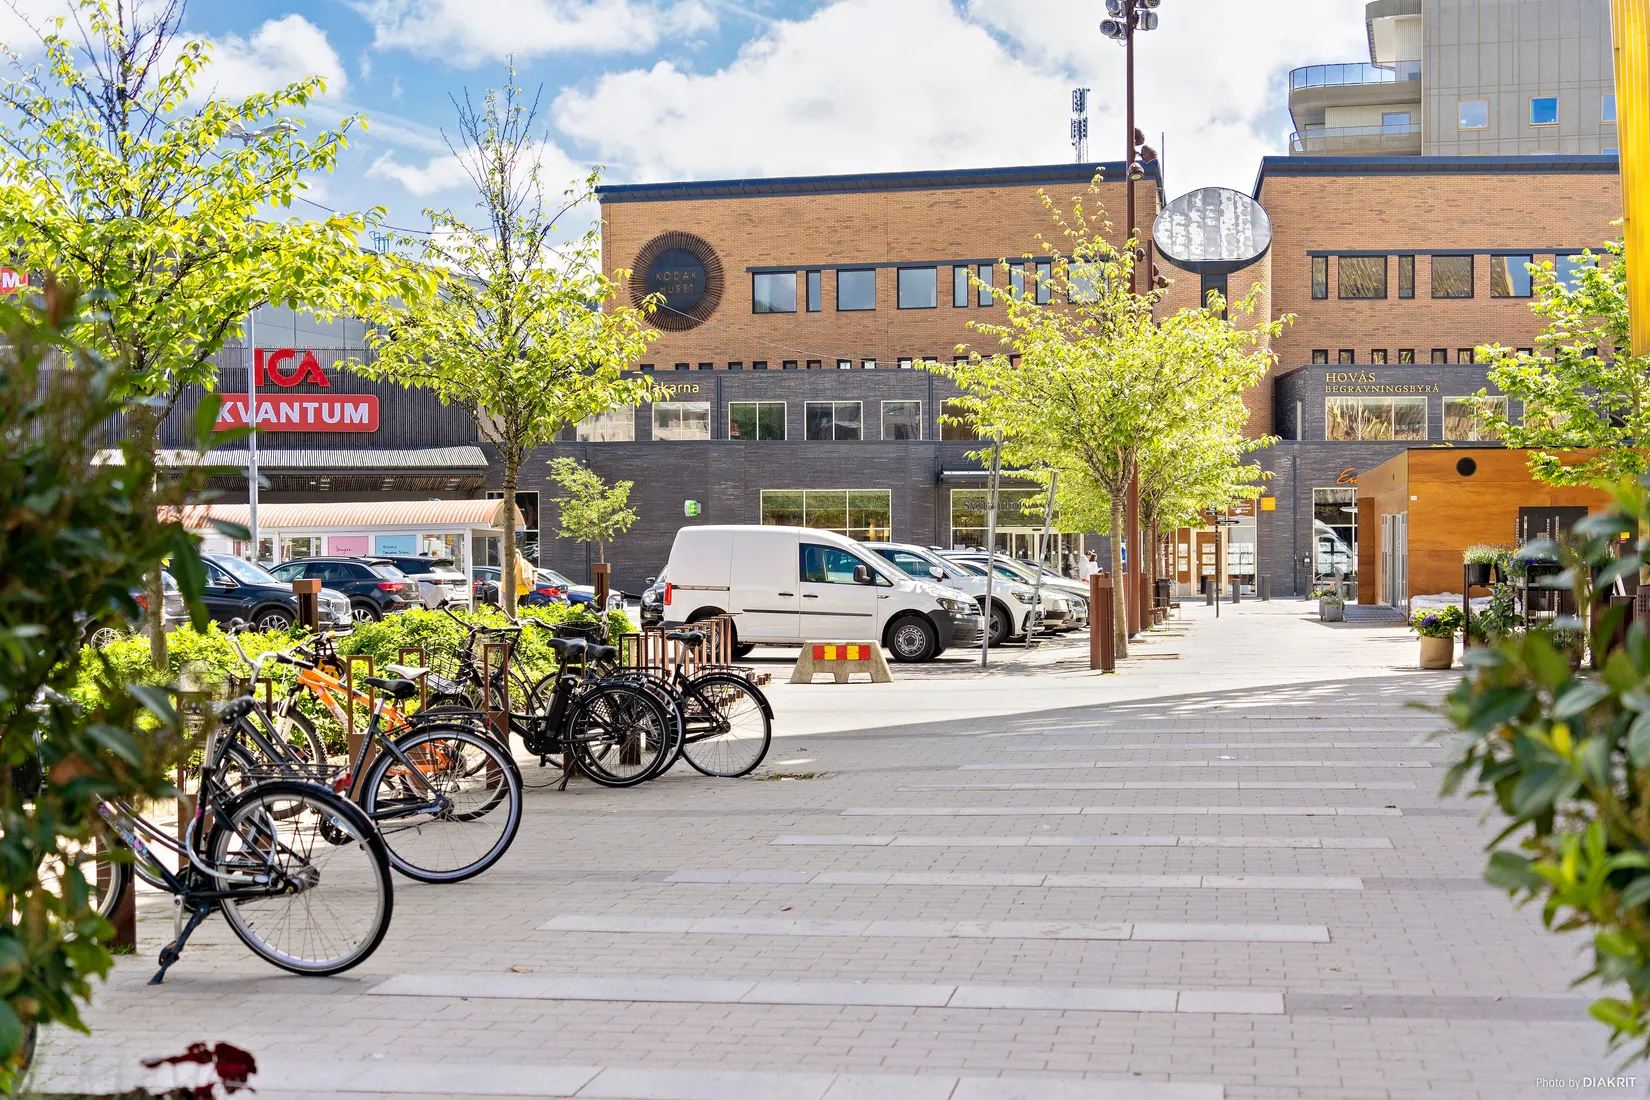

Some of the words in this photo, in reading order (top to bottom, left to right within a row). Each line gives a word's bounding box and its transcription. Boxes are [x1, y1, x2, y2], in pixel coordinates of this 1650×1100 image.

[655, 270, 697, 281] KODAK
[660, 283, 695, 294] HUSET
[254, 347, 331, 387] ICA
[1326, 370, 1377, 383] HOVÅS
[1325, 383, 1440, 393] BEGRAVNINGSBYRÅ
